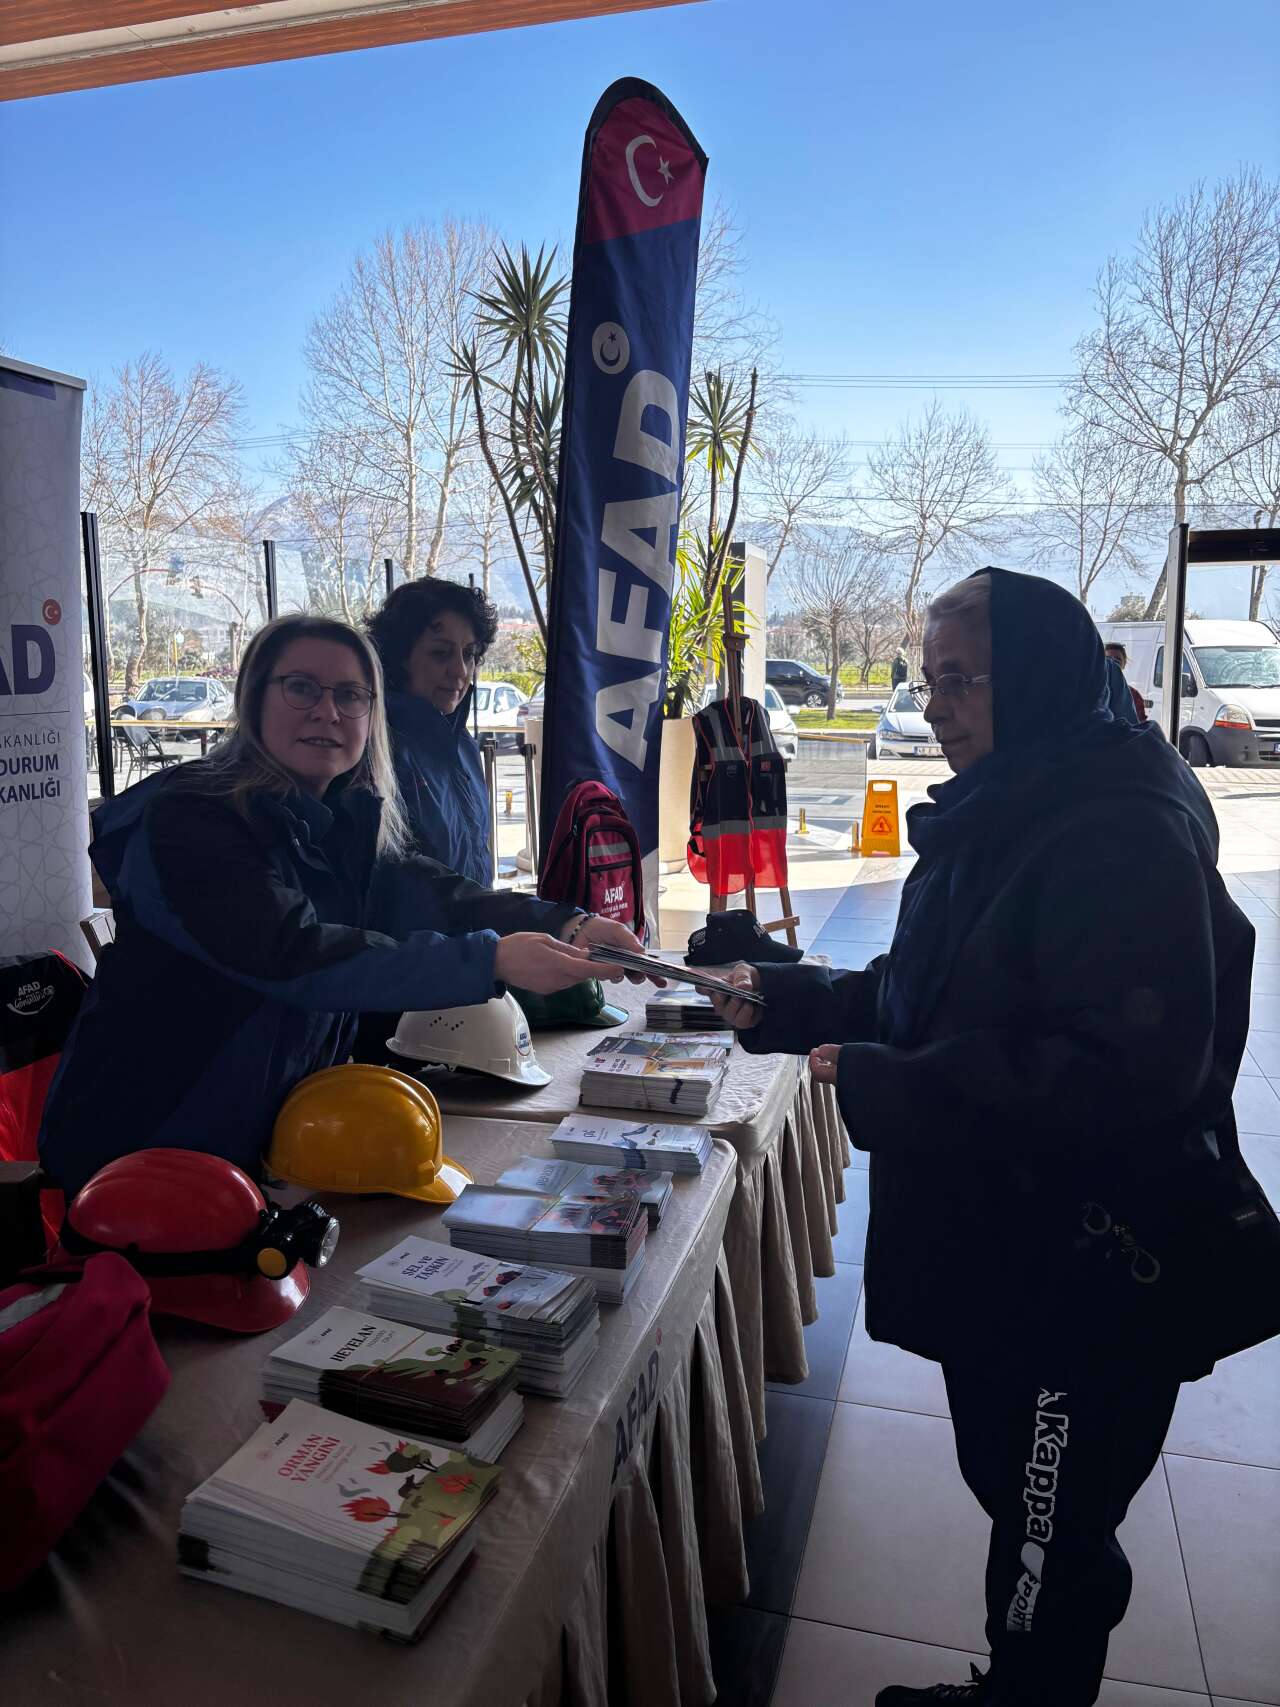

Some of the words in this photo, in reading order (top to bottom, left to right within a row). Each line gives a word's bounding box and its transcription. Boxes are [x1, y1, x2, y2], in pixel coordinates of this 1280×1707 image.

[595, 369, 679, 771] AFAD
[0, 624, 56, 696] D
[0, 729, 61, 749] KANLIĞI
[604, 886, 624, 905] AFAD
[18, 981, 41, 997] AFAD
[401, 1264, 423, 1276] SEL
[418, 1255, 433, 1267] ve
[414, 1256, 450, 1281] TAŞKIN
[329, 1324, 377, 1362] HEYELAN
[610, 1349, 659, 1486] AFAD
[277, 1433, 323, 1477] ORMAN
[290, 1437, 341, 1482] YANGINI
[1023, 1410, 1069, 1543] Kappa
